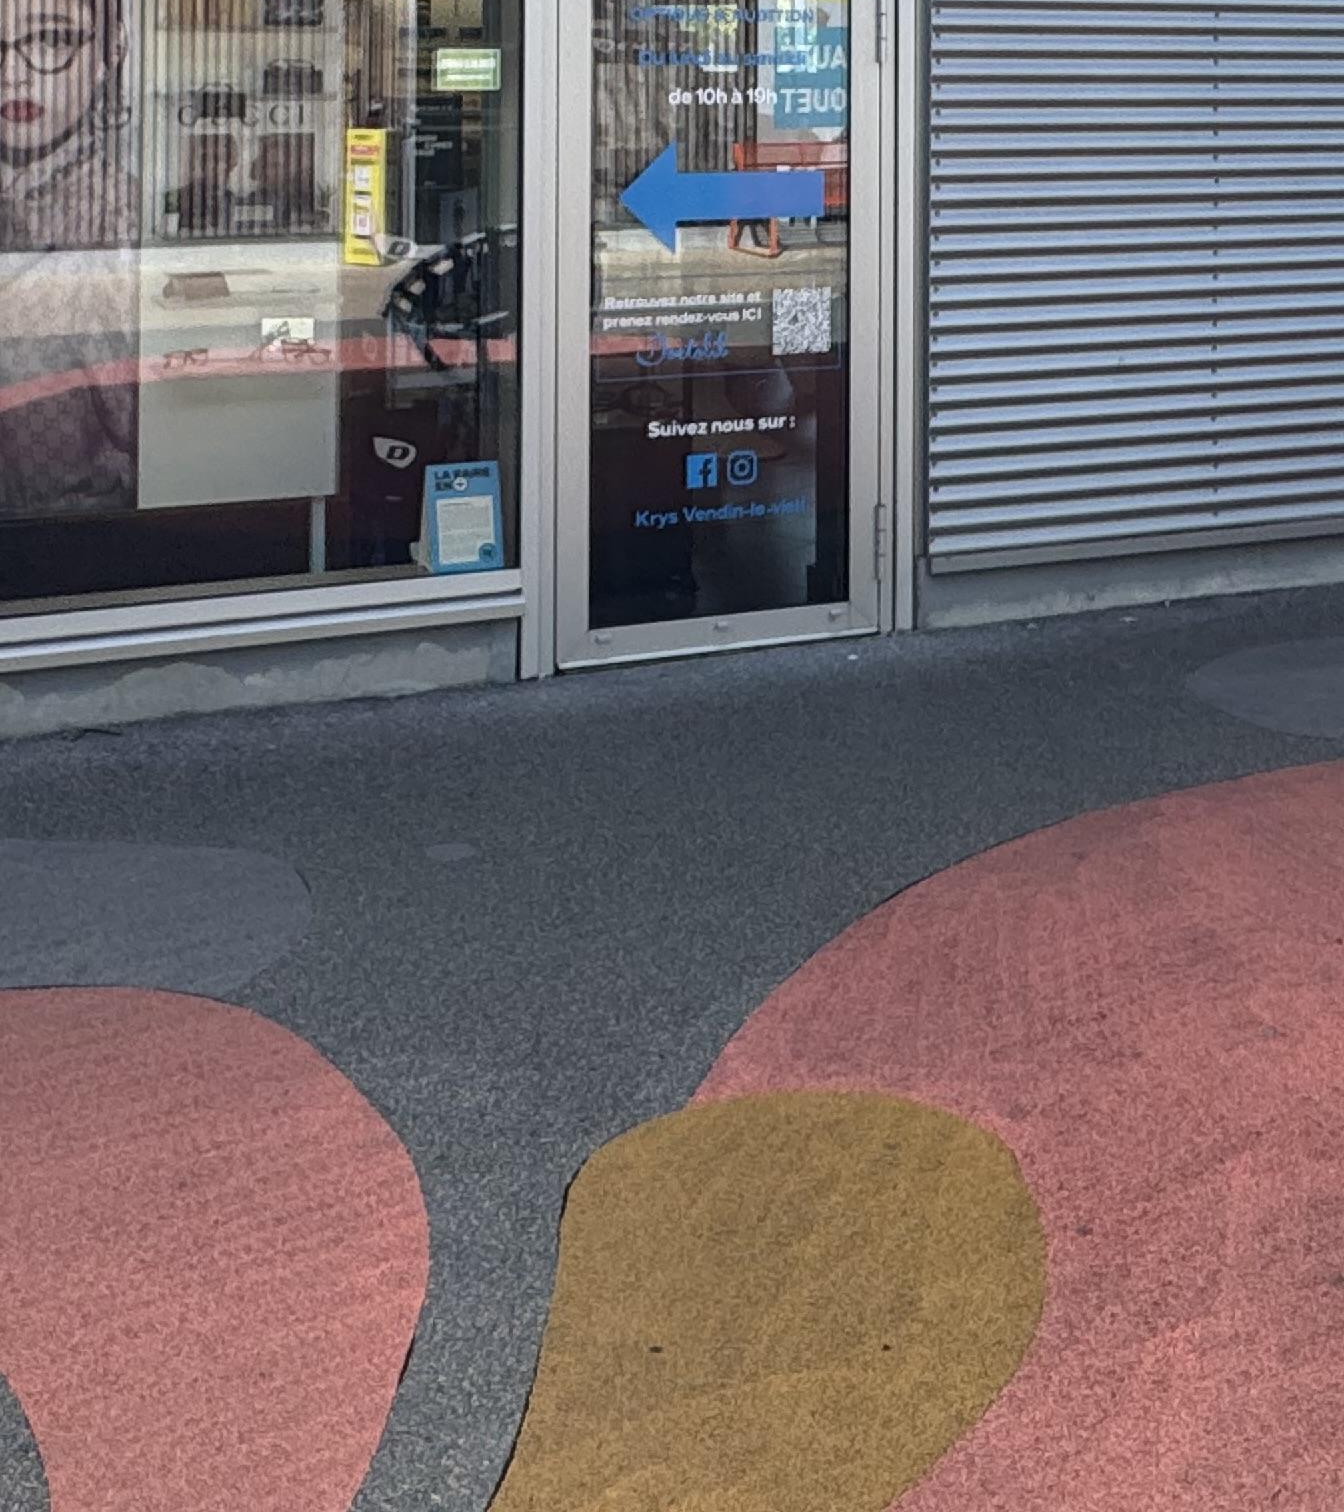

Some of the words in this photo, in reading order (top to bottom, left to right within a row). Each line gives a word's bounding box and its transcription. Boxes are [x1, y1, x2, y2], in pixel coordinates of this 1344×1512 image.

[668, 88, 692, 105] de
[696, 88, 727, 105] 10h
[731, 87, 743, 105] à
[747, 88, 778, 105] 19h
[680, 294, 715, 308] notre
[719, 292, 743, 305] site
[747, 291, 762, 303] et
[603, 316, 652, 331] prenez
[656, 309, 740, 326] rendez-vous
[742, 308, 762, 321] ICI
[648, 420, 708, 439] Suivez
[711, 417, 754, 433] nous
[759, 416, 786, 431] sur
[635, 509, 678, 529] Krys
